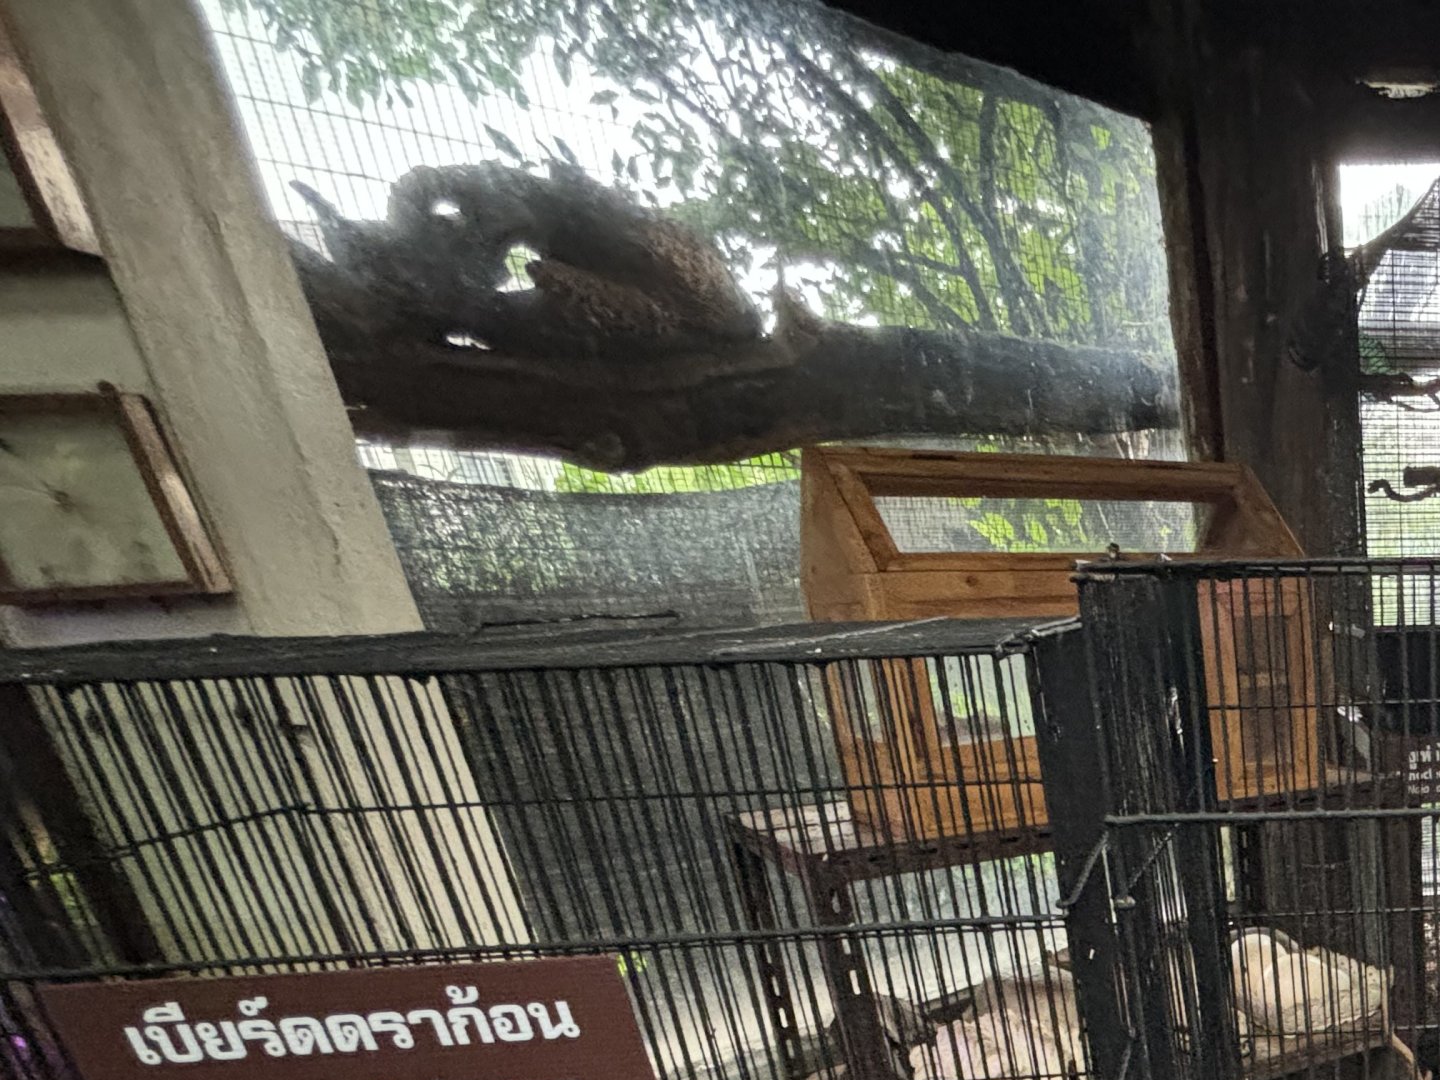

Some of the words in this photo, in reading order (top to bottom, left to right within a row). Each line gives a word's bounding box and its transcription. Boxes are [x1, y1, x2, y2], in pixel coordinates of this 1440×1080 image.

[124, 984, 581, 1065] เบียร์ดดราก้อน
